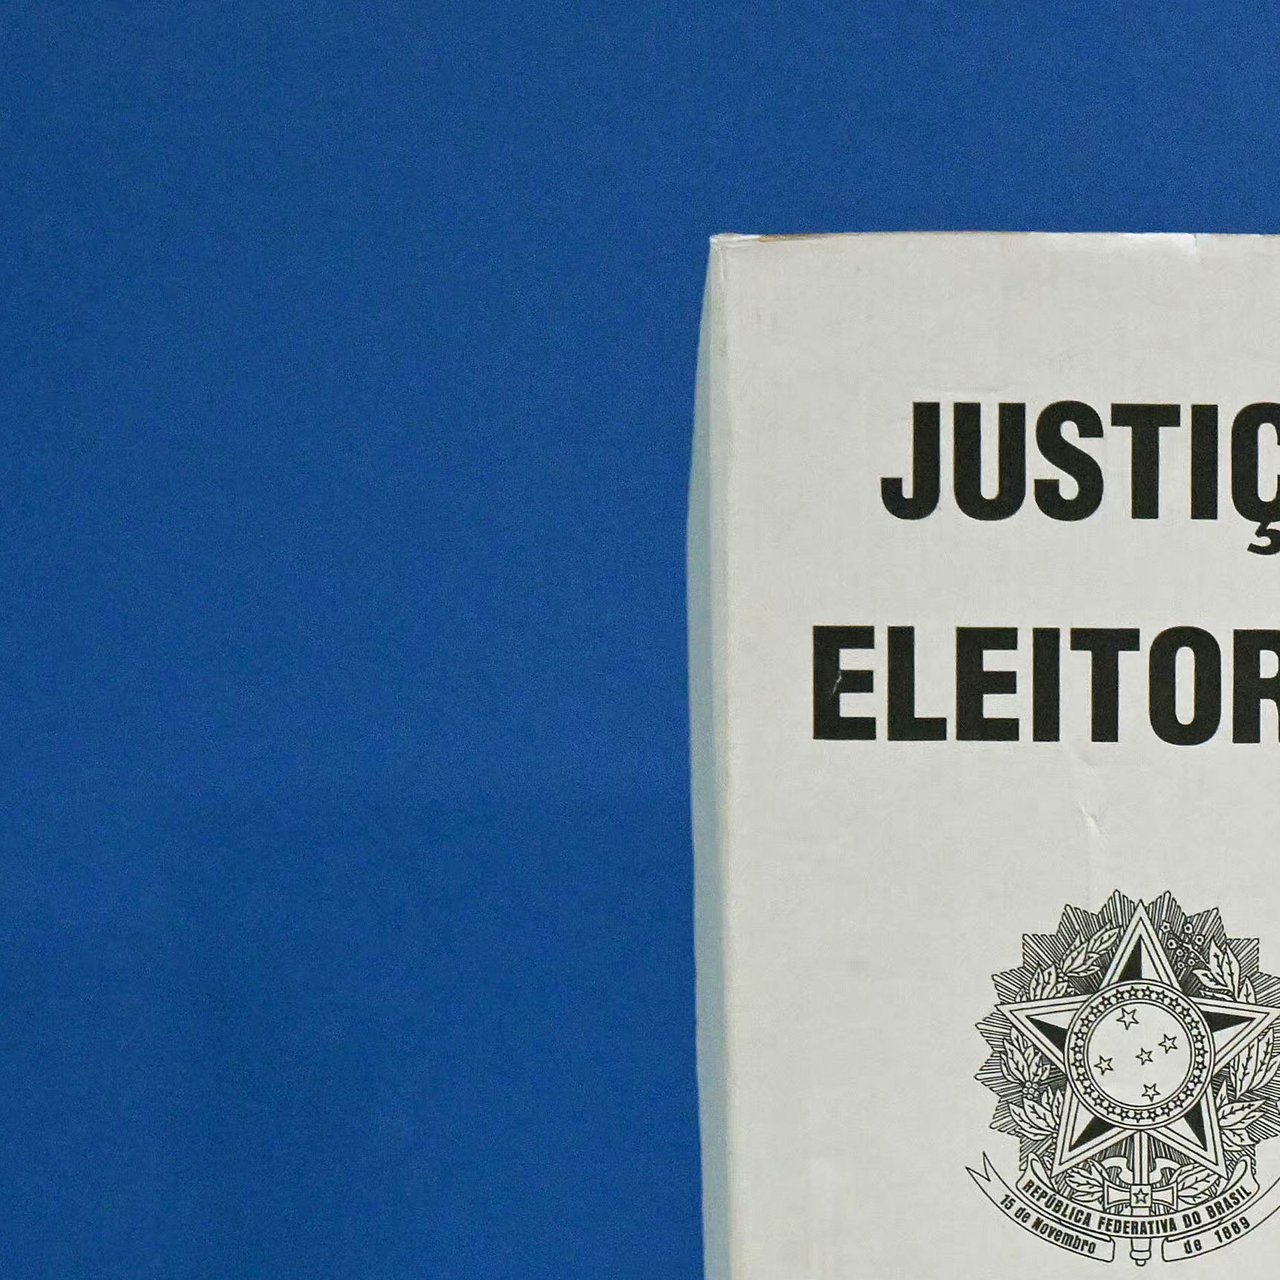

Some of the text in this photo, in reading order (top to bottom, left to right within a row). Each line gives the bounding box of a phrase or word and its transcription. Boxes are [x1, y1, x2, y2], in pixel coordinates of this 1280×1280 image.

[1000, 1194, 1251, 1255] 15 de Novembro de 1889
[1022, 1179, 1252, 1235] REPÚBLICA FEDERATIVA DO BRASIL
